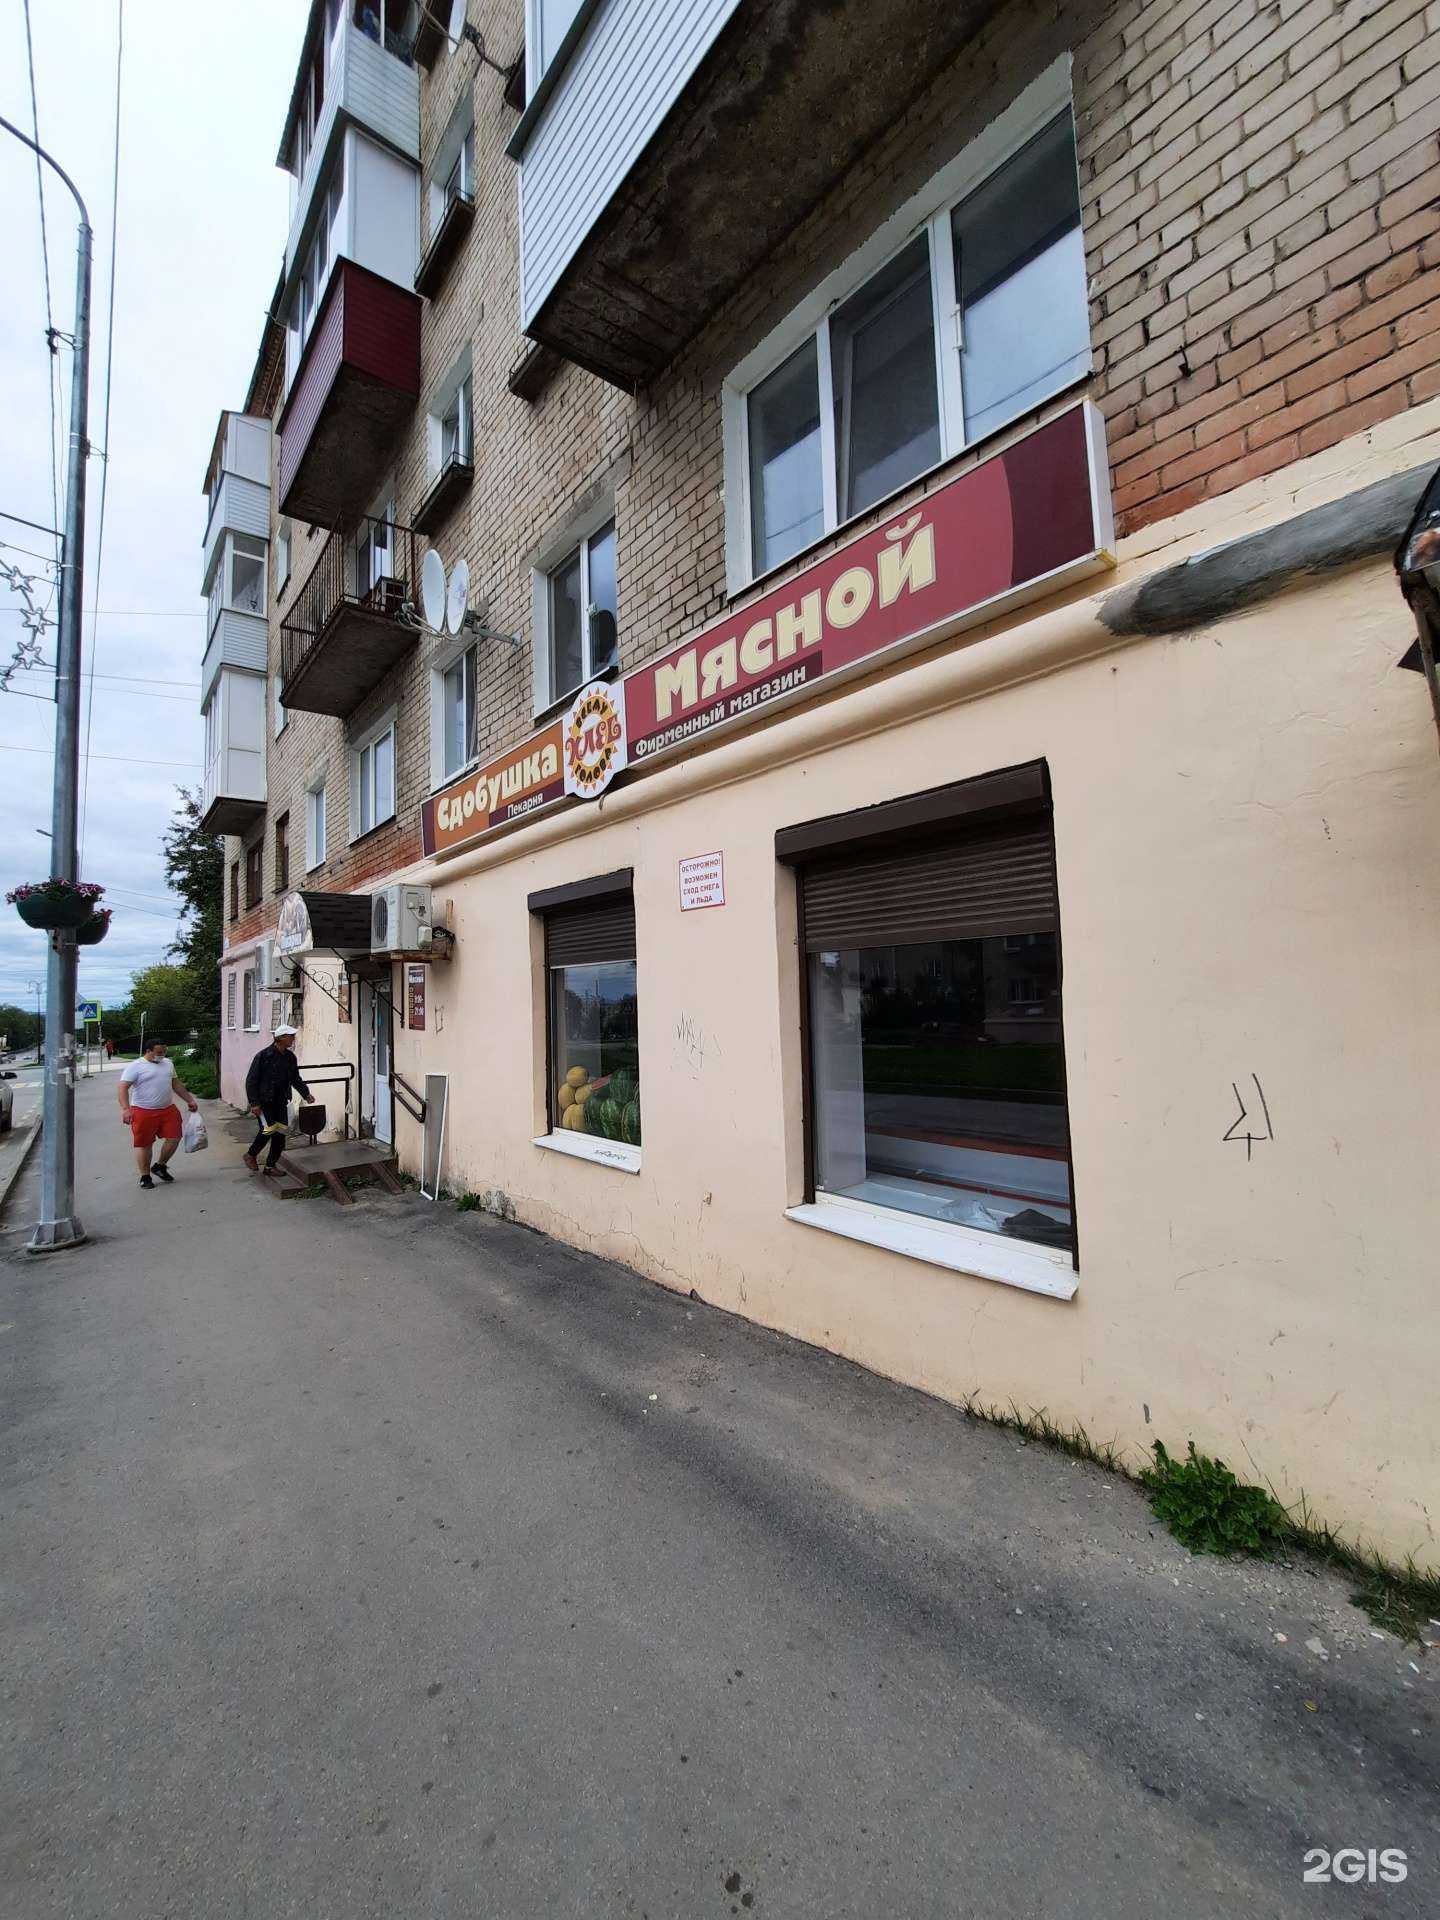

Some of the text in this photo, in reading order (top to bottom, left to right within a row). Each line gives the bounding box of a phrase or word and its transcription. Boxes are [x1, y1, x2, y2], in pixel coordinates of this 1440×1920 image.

[654, 512, 937, 722] Мясной
[635, 665, 806, 757] Фирменный магазин
[437, 743, 558, 831] Сдобушка
[507, 793, 543, 818] Пекарня
[681, 858, 721, 872] ОСТОРОЖНО!
[684, 871, 718, 884] ВОЗМОЖЕН
[683, 882, 720, 895] СХОД СНЕГА
[696, 895, 713, 903] ЛЬДА
